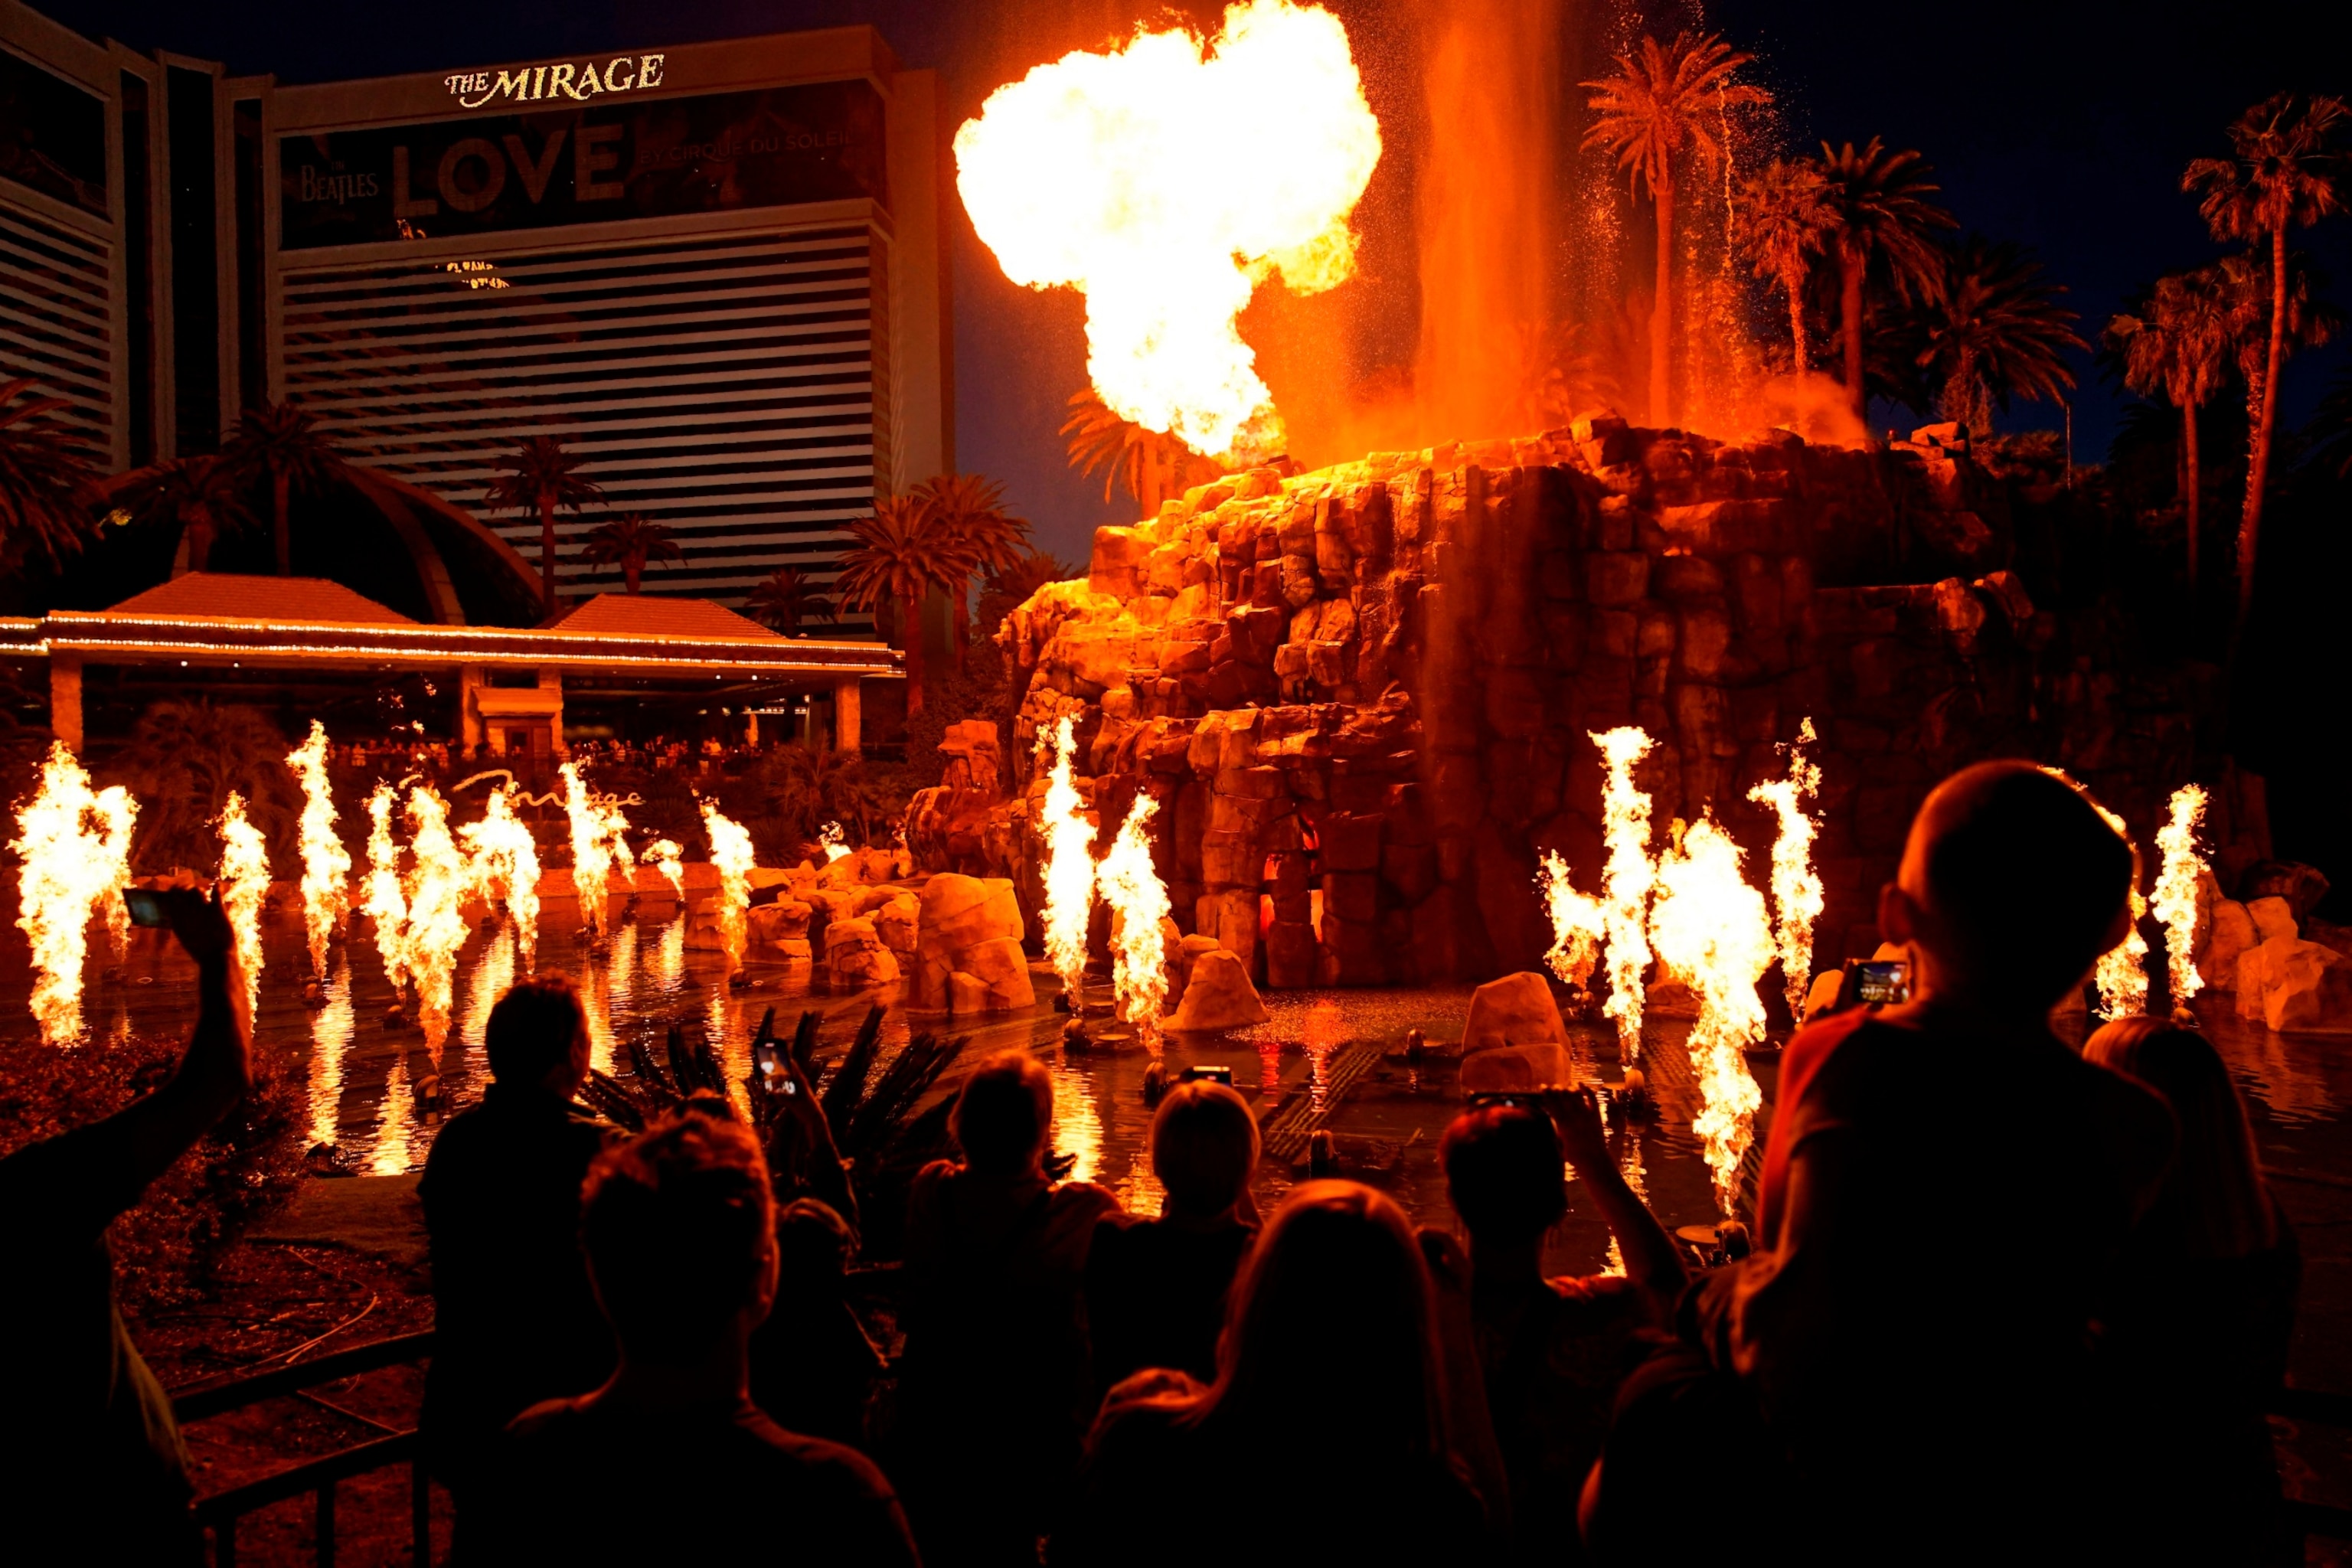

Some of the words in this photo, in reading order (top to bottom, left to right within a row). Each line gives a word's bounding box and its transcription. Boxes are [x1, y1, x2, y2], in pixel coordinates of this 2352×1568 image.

[444, 72, 489, 94] THE
[459, 54, 665, 108] MIRAGE
[640, 147, 665, 165] BY
[668, 127, 743, 162] CIRQUE
[750, 136, 779, 154] DU
[785, 130, 855, 151] SOLEIL
[300, 163, 379, 206] BEATLES
[392, 122, 625, 218] LOVE
